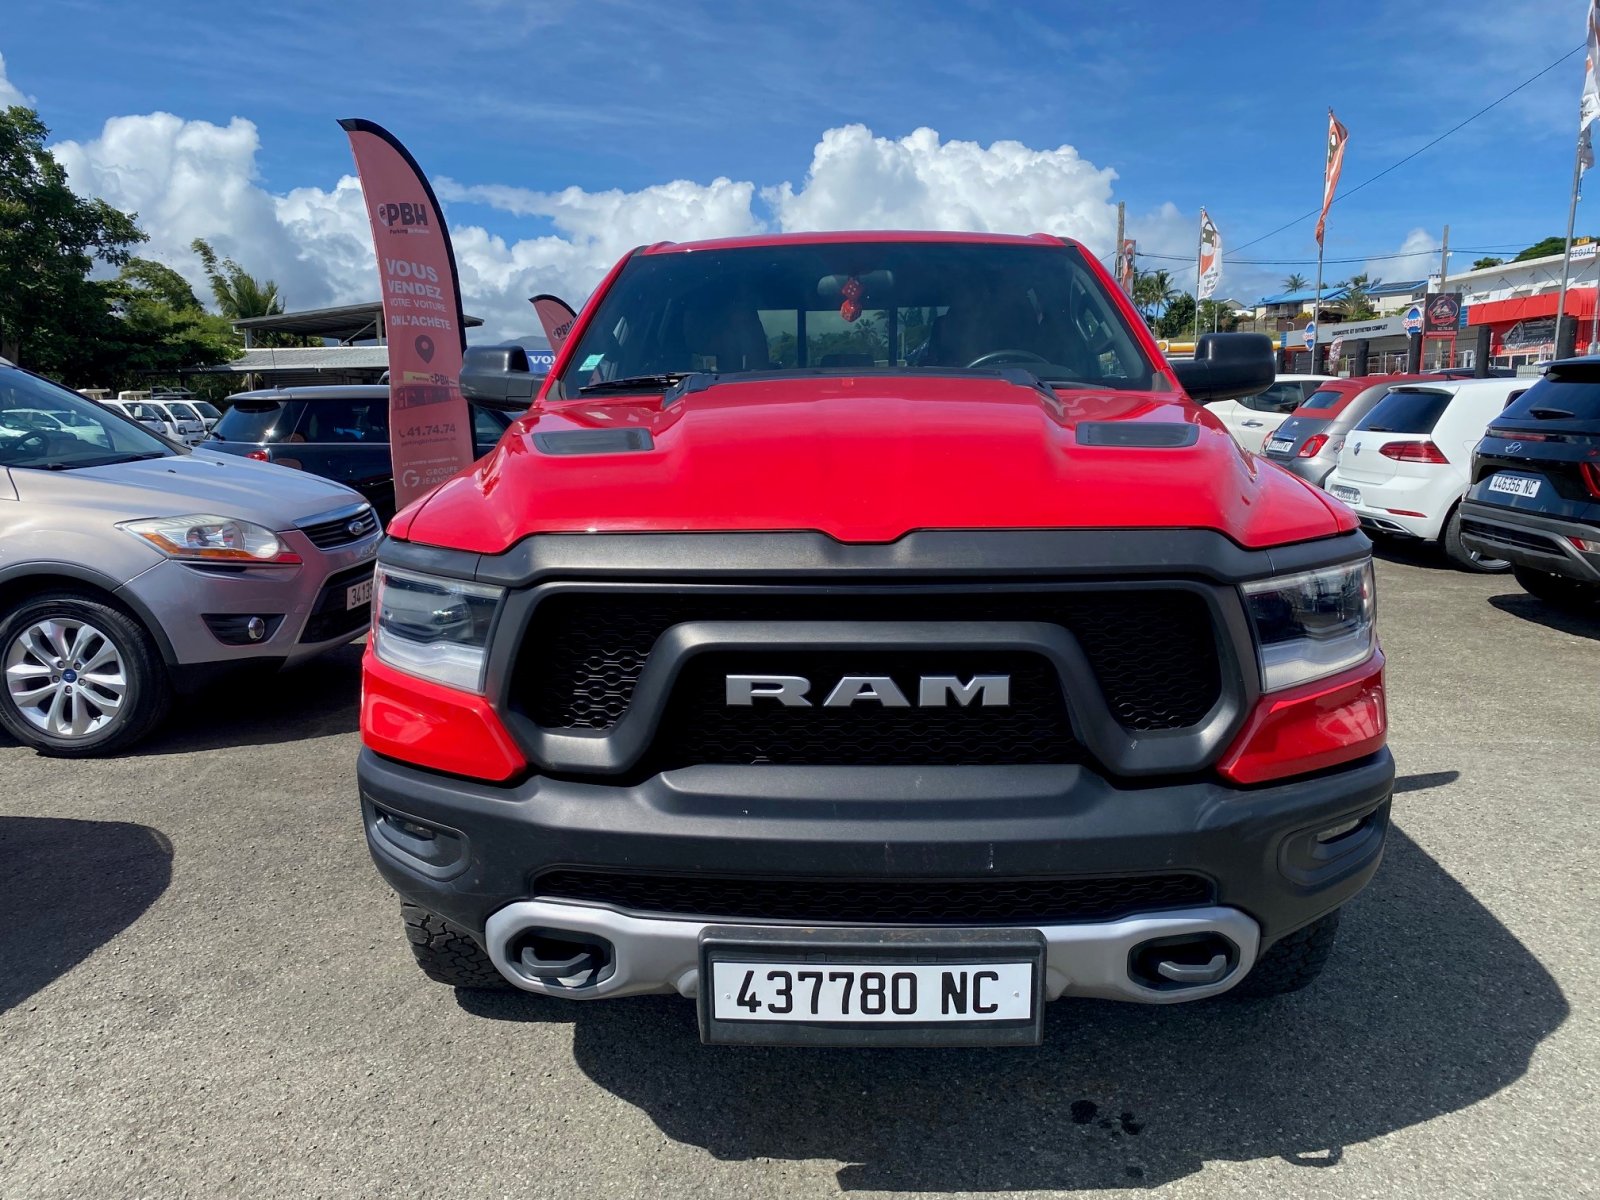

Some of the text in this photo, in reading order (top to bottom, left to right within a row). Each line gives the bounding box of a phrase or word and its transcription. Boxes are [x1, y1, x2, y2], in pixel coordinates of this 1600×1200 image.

[386, 203, 428, 226] PBH
[385, 258, 438, 283] VOUS
[387, 280, 443, 299] VENDEZ
[414, 299, 447, 313] VOITURE
[407, 424, 456, 437] 41.74.74
[1493, 476, 1536, 494] 446356 NC
[726, 674, 1010, 706] RAM
[736, 970, 998, 1015] 437780 NC
